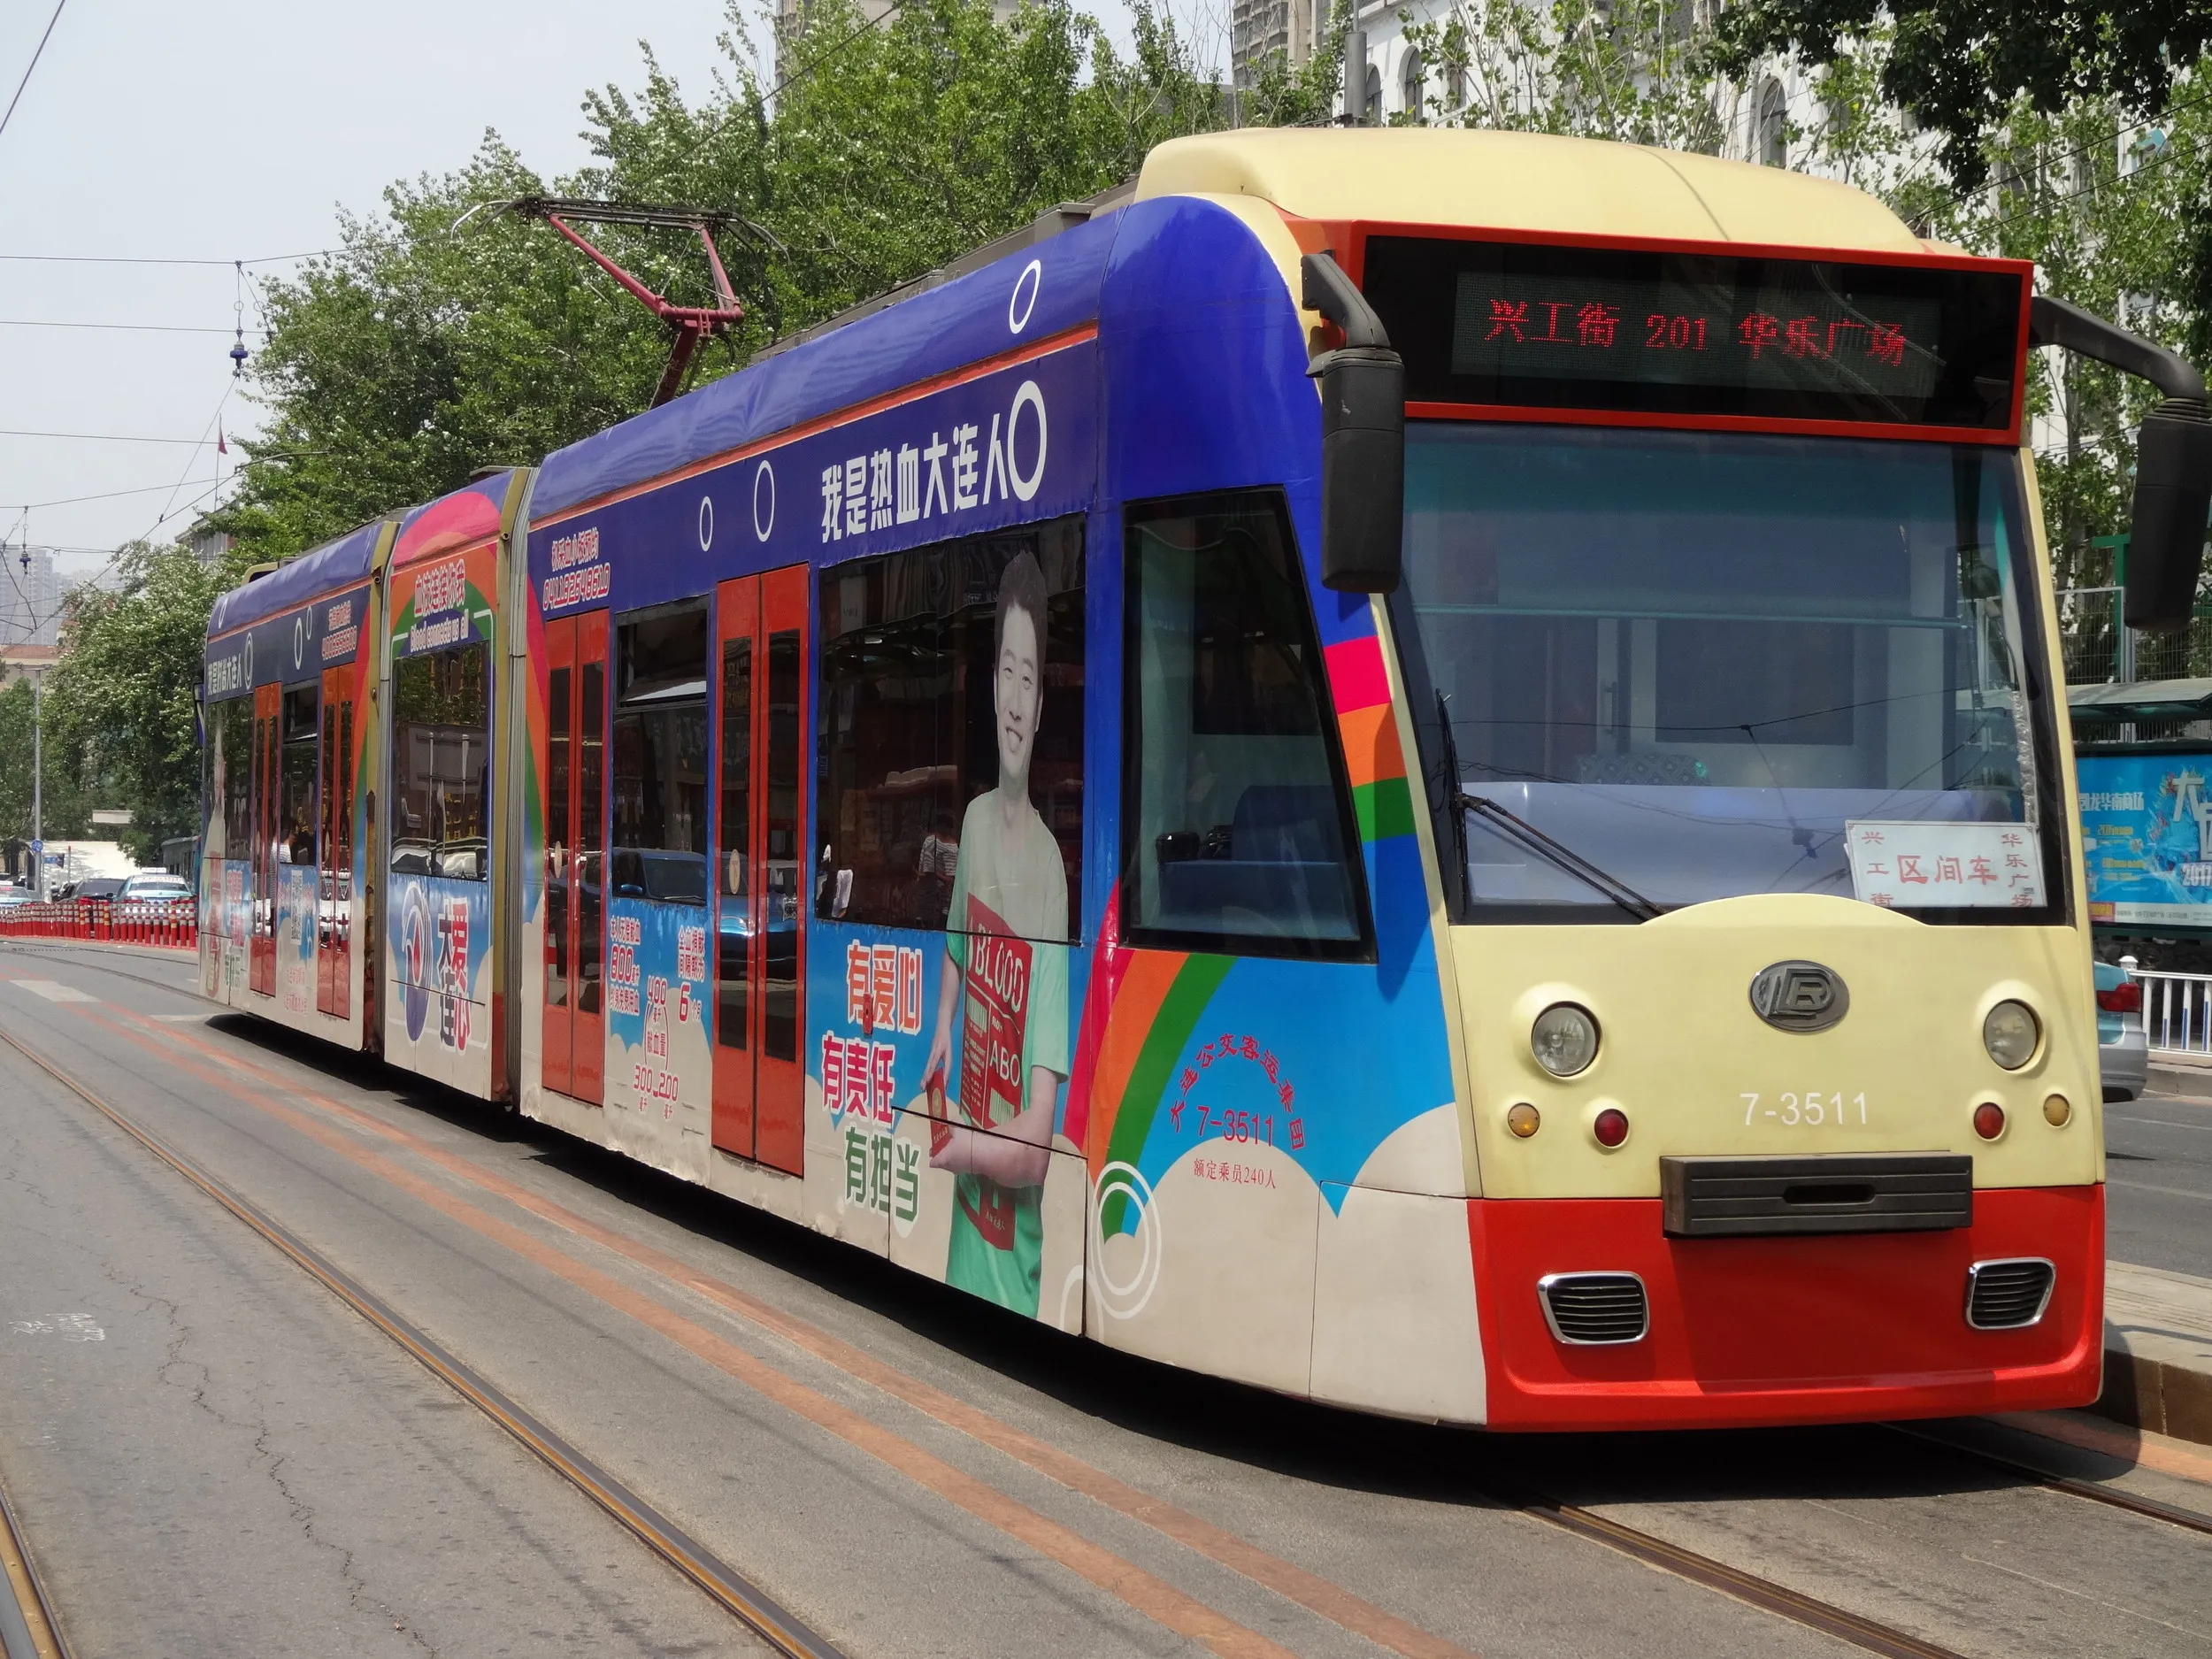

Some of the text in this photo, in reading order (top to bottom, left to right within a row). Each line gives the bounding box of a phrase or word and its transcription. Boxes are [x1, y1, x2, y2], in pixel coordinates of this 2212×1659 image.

[1484, 298, 1905, 367] 兴工街 201 华乐广场
[821, 412, 1009, 543] 我是热血大连人
[1897, 855, 1998, 885] 区间车
[847, 940, 922, 1035] 有爱心
[822, 1030, 895, 1129] 有责任
[990, 1040, 1020, 1087] ABO
[1197, 1105, 1273, 1147] 7-3511
[1740, 1092, 1869, 1126] 7-3511
[845, 1125, 920, 1224] 有担当
[1194, 1158, 1276, 1189] 额定乘员240人
